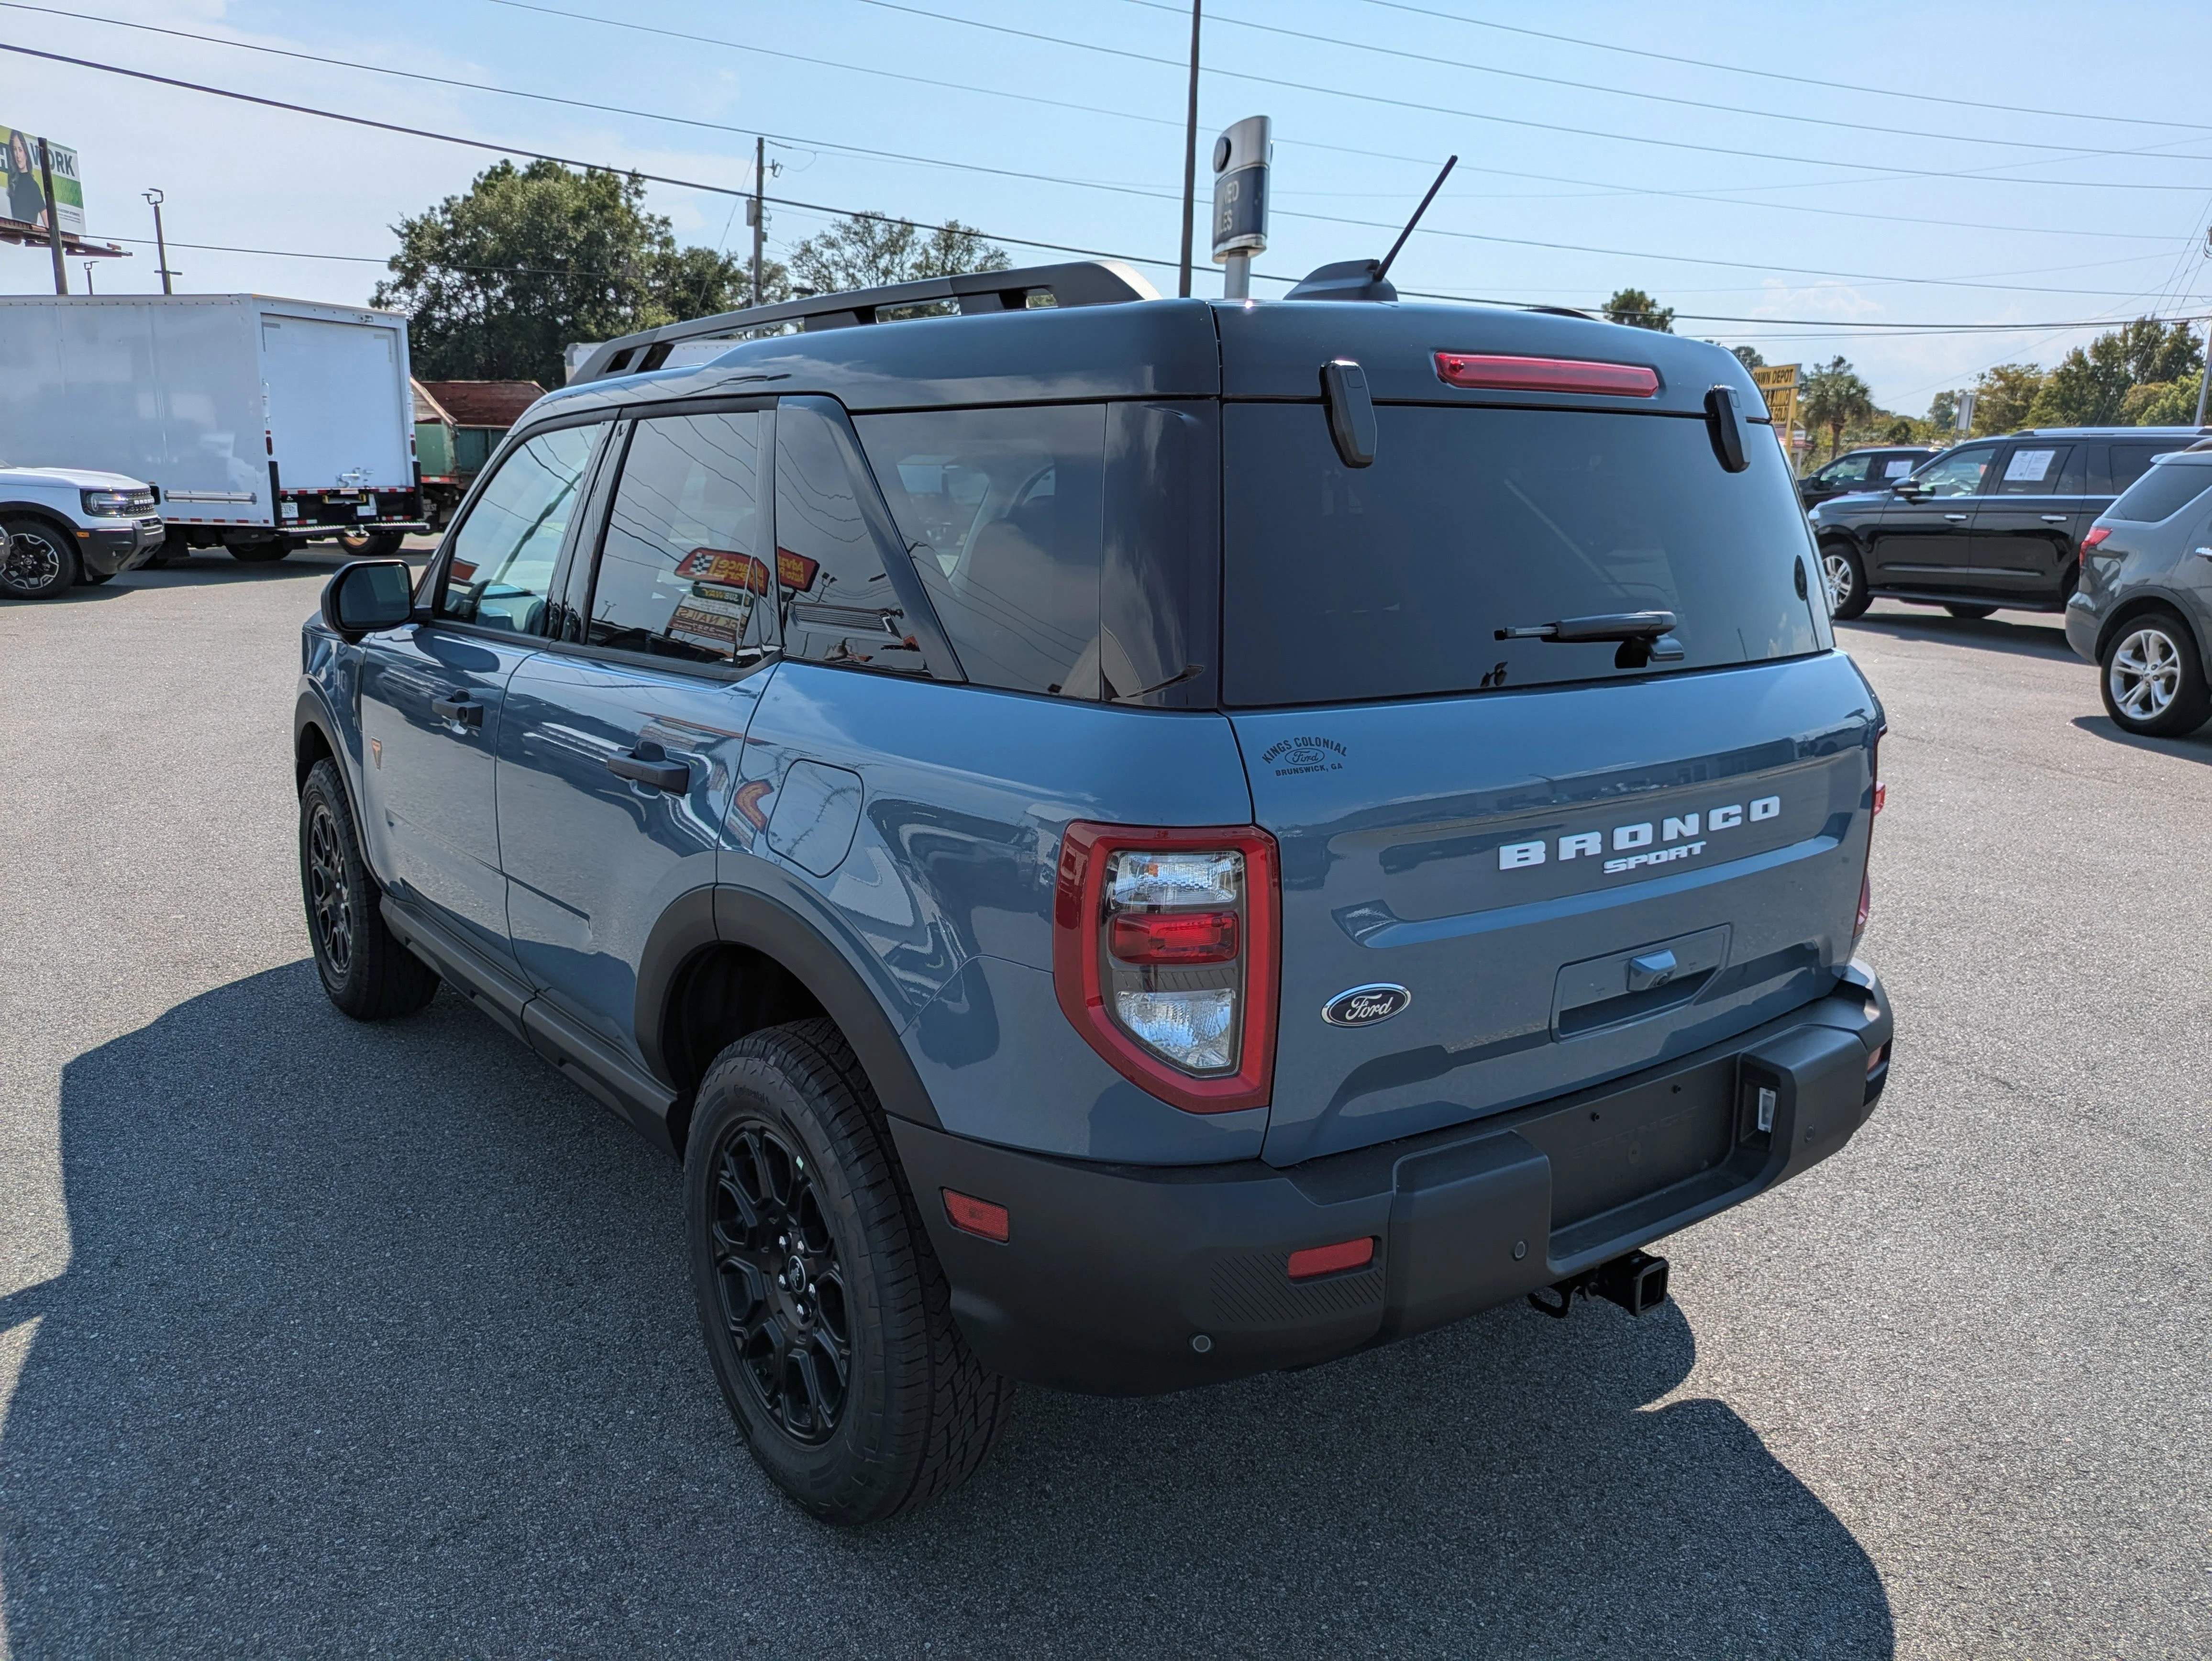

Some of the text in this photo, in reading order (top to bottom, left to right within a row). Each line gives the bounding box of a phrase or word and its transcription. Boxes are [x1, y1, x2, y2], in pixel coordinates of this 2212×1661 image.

[1772, 369, 1793, 384] DEPOT
[1262, 736, 1347, 764] KINGS COLONIAL
[1292, 750, 1319, 763] Ford
[1275, 764, 1329, 776] BRUNSWICK,
[1499, 796, 1780, 870] BRONCO
[1603, 841, 1706, 874] SPORT
[1345, 993, 1394, 1020] Ford
